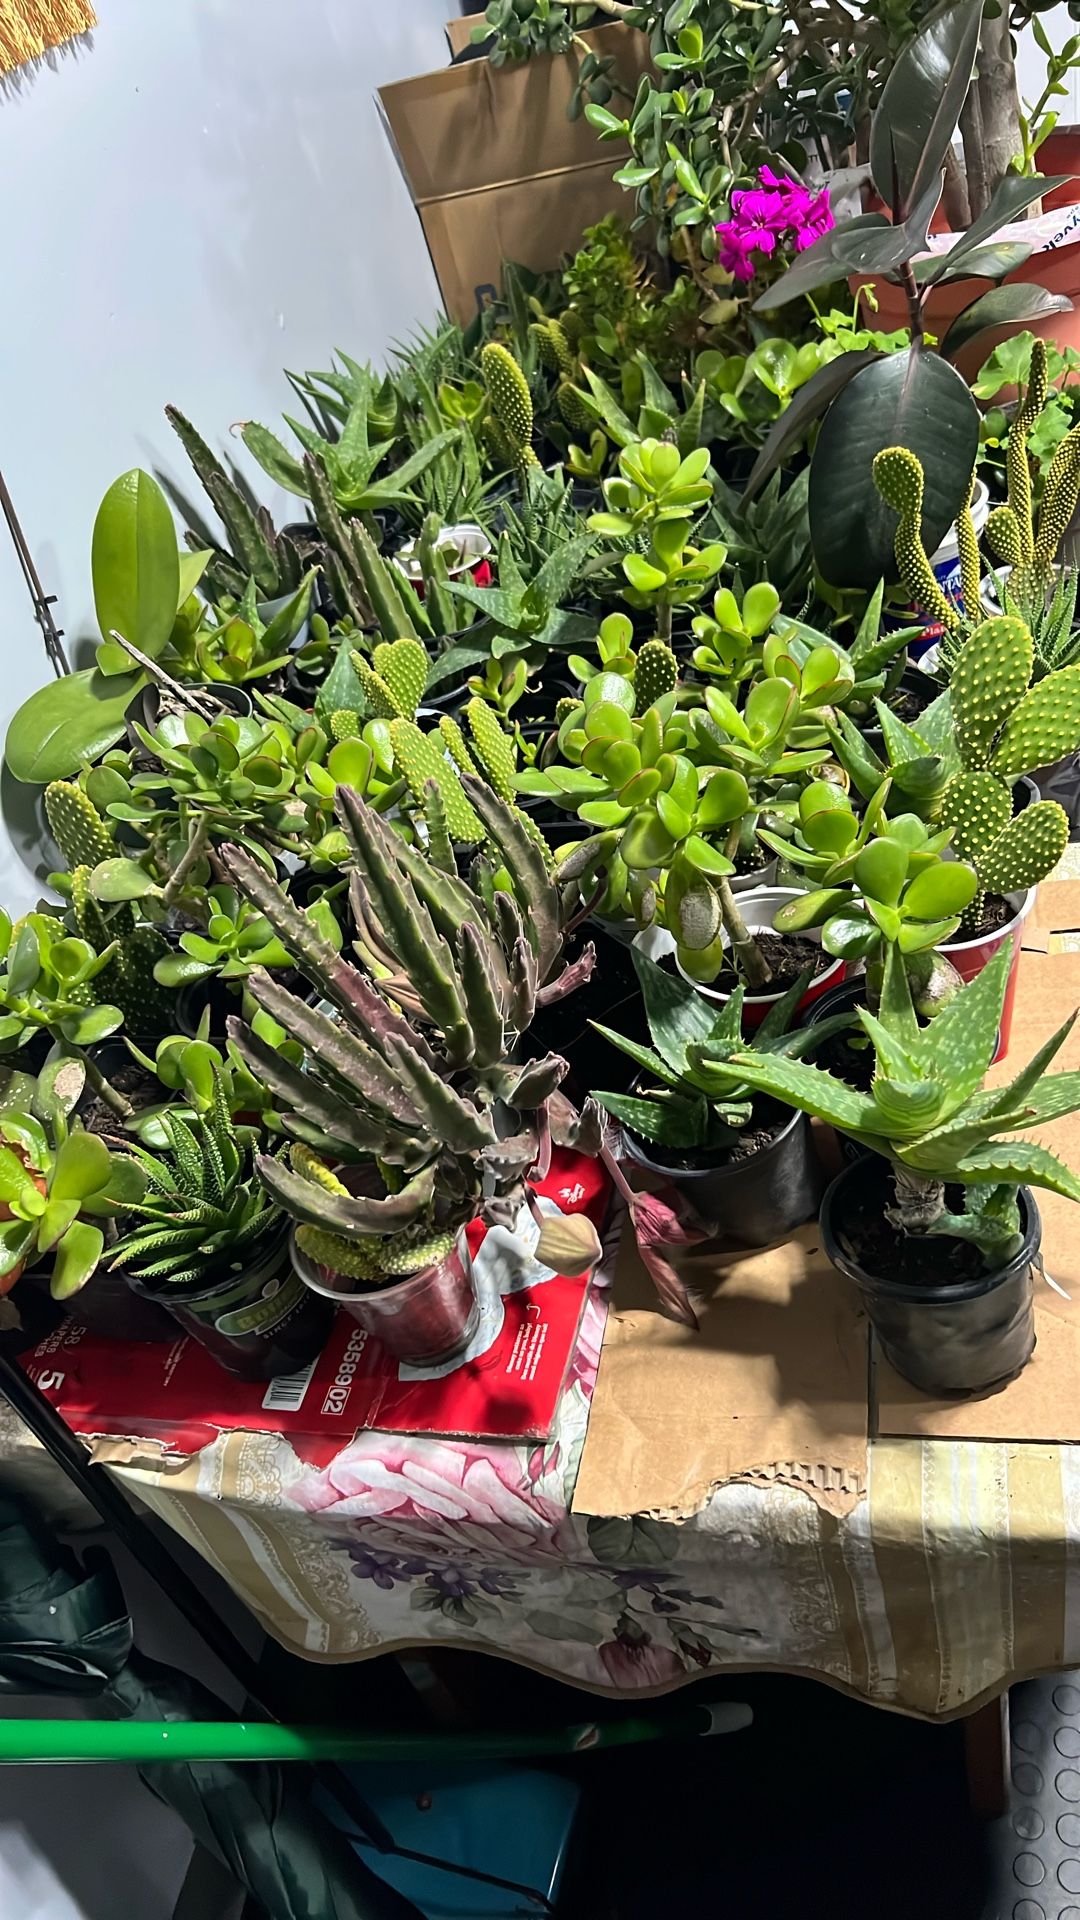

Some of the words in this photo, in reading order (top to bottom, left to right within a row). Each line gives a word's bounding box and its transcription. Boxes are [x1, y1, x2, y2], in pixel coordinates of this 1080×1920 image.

[1042, 215, 1080, 251] yvek
[64, 1326, 87, 1345] 58
[37, 1369, 65, 1390] 5
